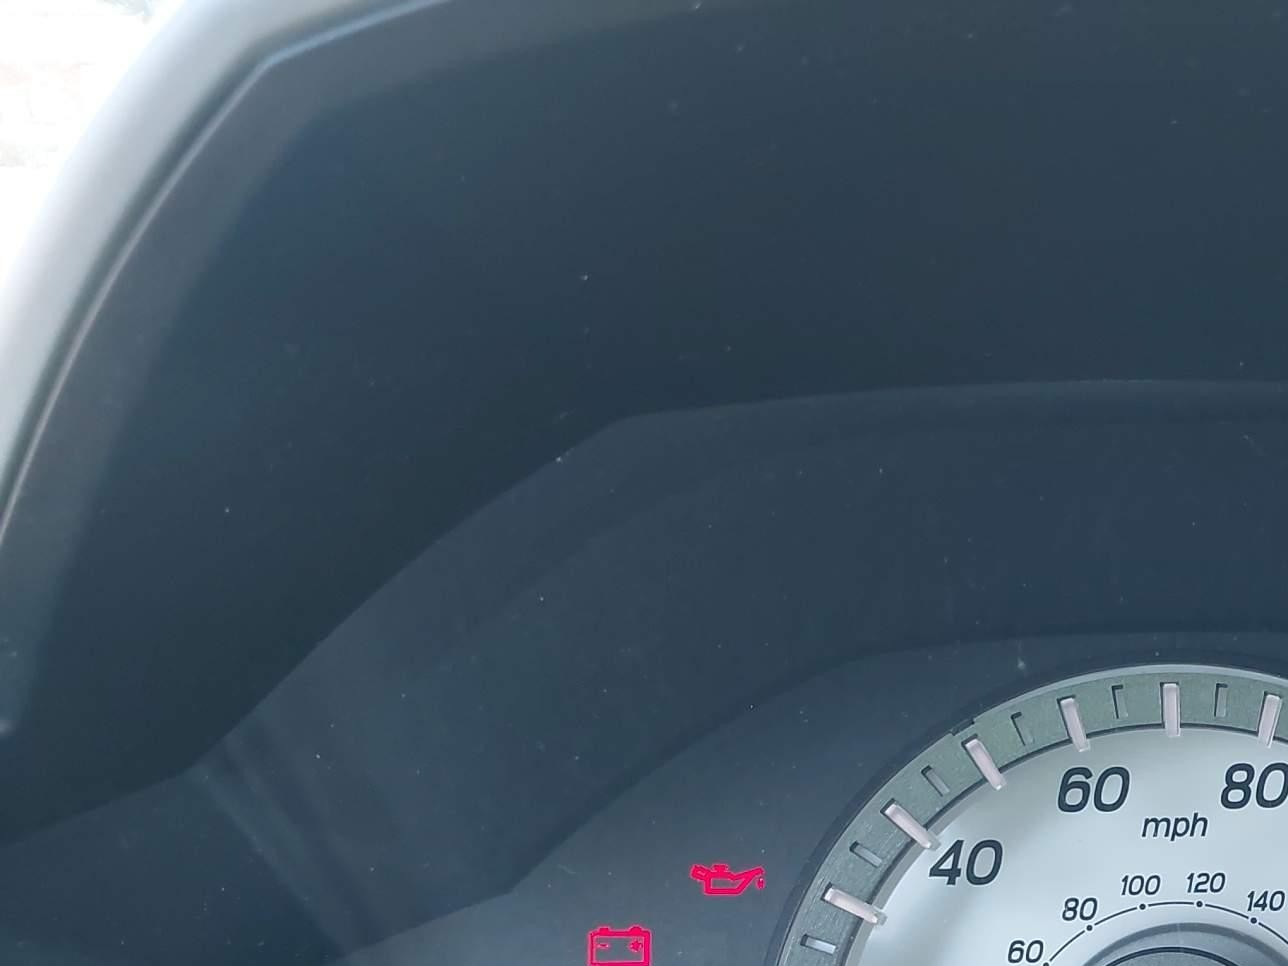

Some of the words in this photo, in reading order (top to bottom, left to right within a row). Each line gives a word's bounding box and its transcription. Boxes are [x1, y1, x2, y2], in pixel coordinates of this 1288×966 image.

[1057, 766, 1130, 813] 60
[1141, 812, 1208, 842] mph
[929, 840, 1003, 886] 40
[1120, 875, 1160, 896] 100
[1186, 872, 1226, 893] 120
[1061, 897, 1098, 923] 80
[1246, 890, 1286, 911] 140
[1007, 940, 1044, 964] 60
